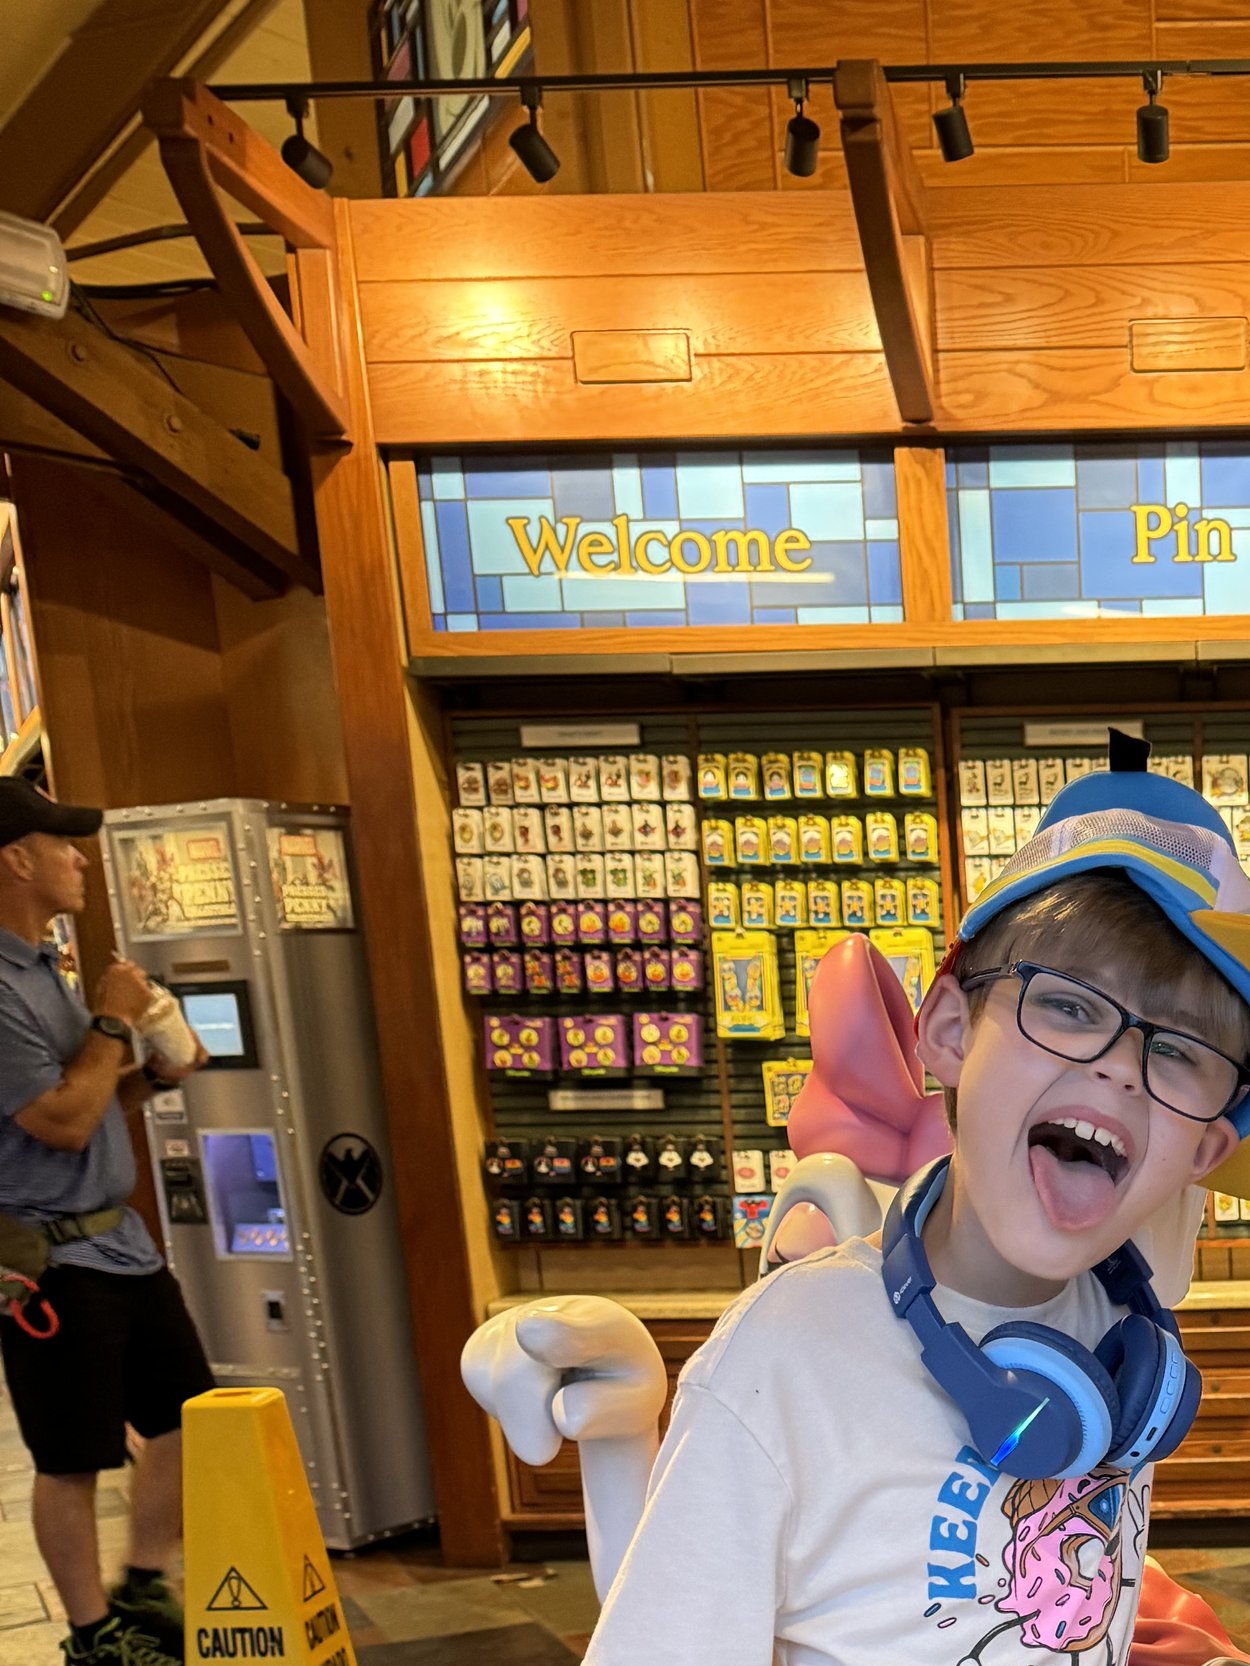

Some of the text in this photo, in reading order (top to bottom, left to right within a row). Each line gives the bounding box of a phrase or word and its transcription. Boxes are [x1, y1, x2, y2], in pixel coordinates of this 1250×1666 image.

[507, 513, 812, 577] Welcome
[1130, 502, 1238, 564] Pin
[198, 1626, 285, 1659] CAUTION
